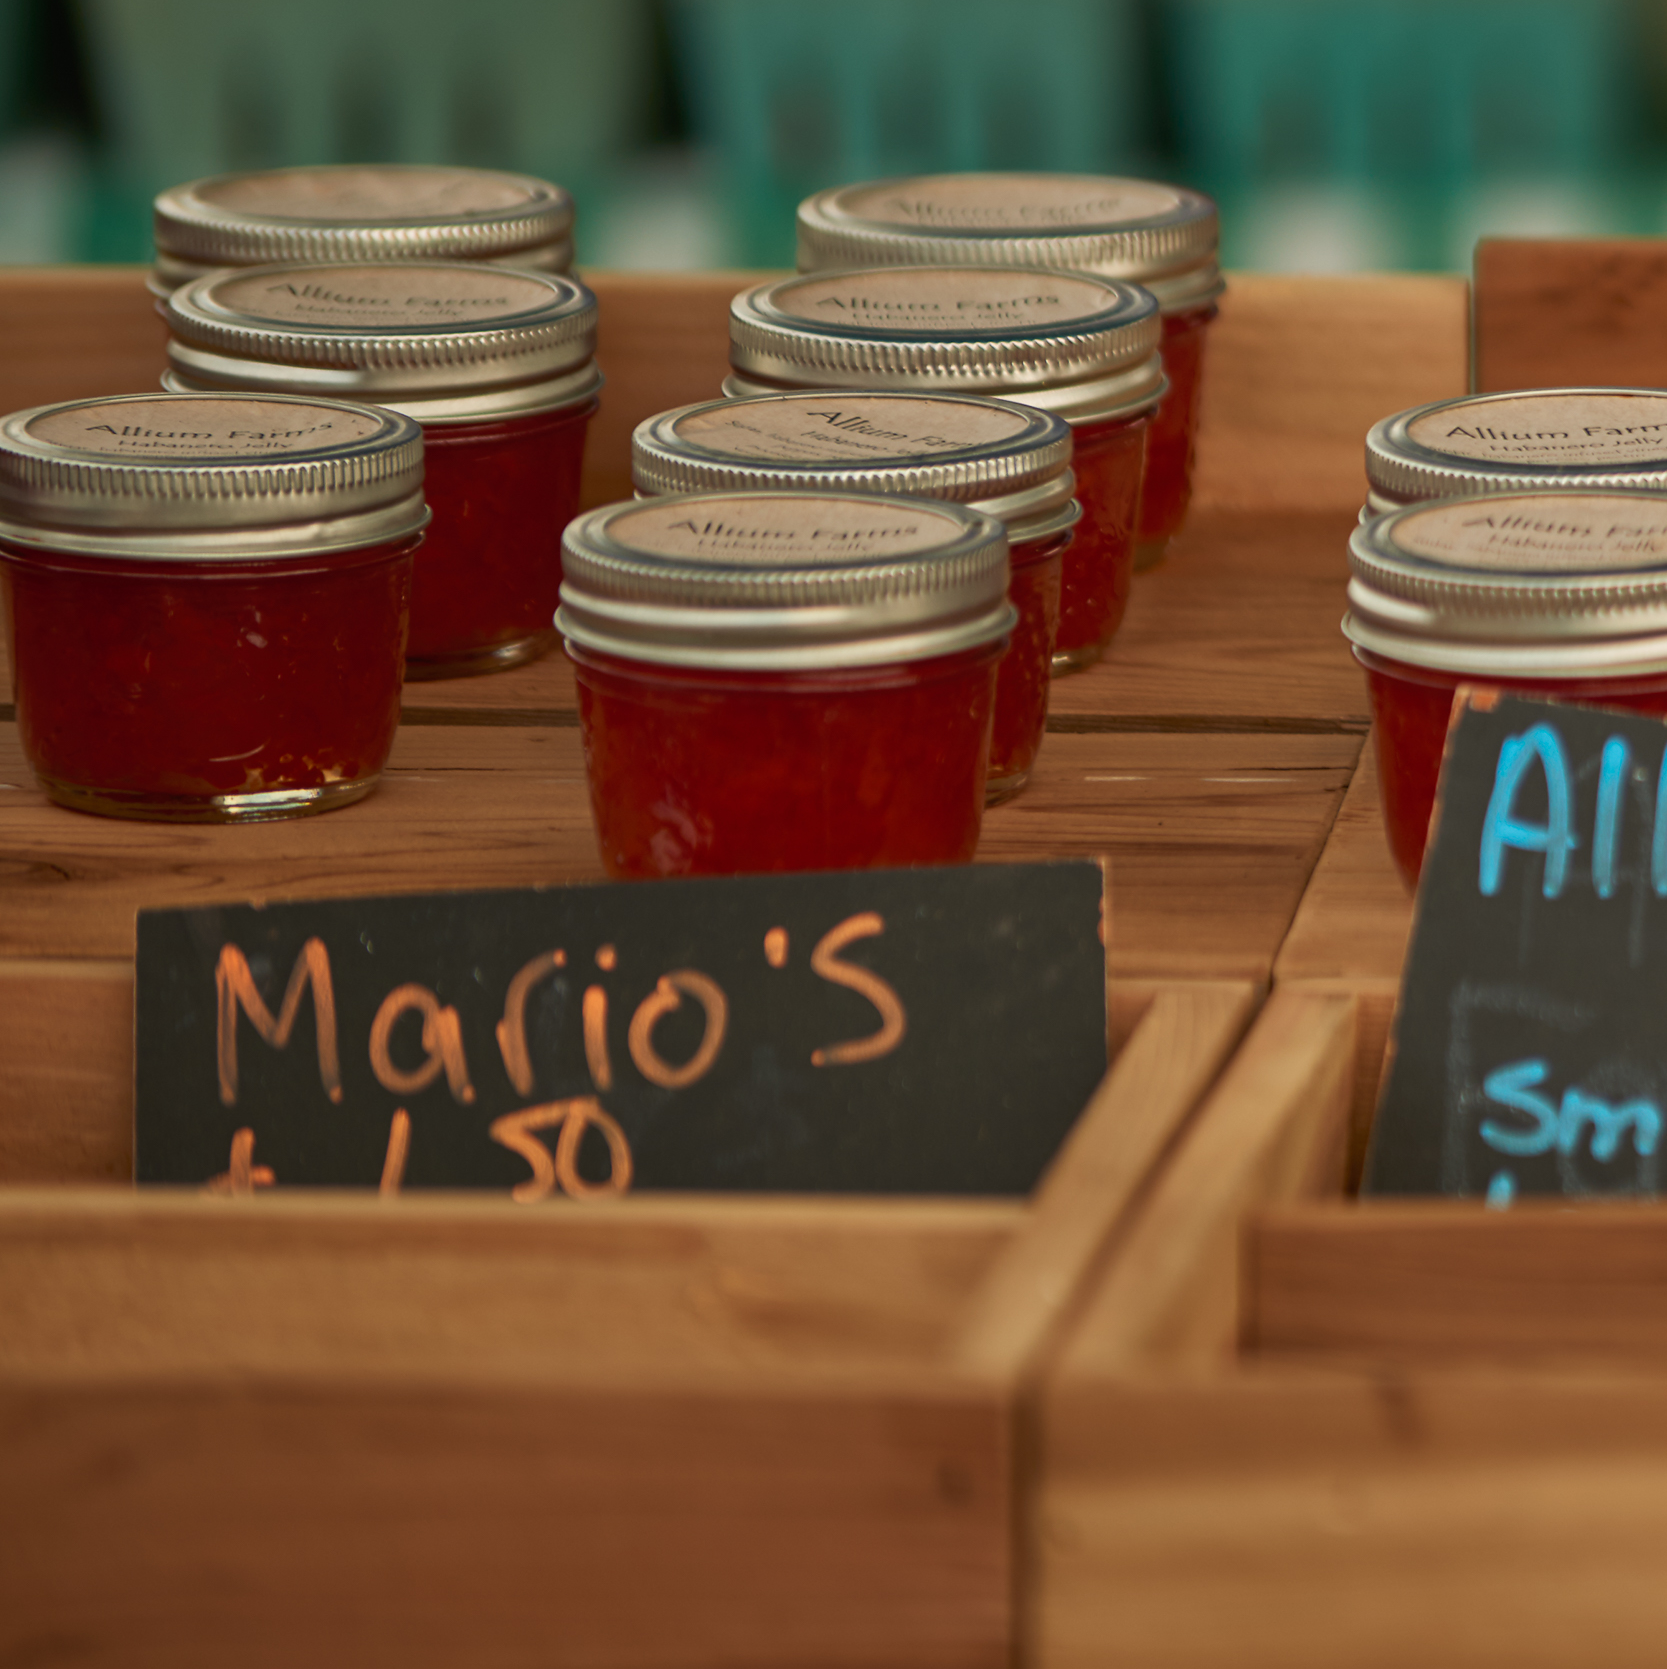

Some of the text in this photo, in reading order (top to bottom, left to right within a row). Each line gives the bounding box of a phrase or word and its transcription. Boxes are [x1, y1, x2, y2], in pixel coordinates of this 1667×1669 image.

[85, 421, 333, 441] Allium Farms
[806, 410, 908, 442] Allium
[1446, 426, 1569, 442] Allium
[1489, 435, 1664, 453] Habanero Jelly
[666, 520, 795, 539] Allium
[1462, 515, 1592, 538] Allium
